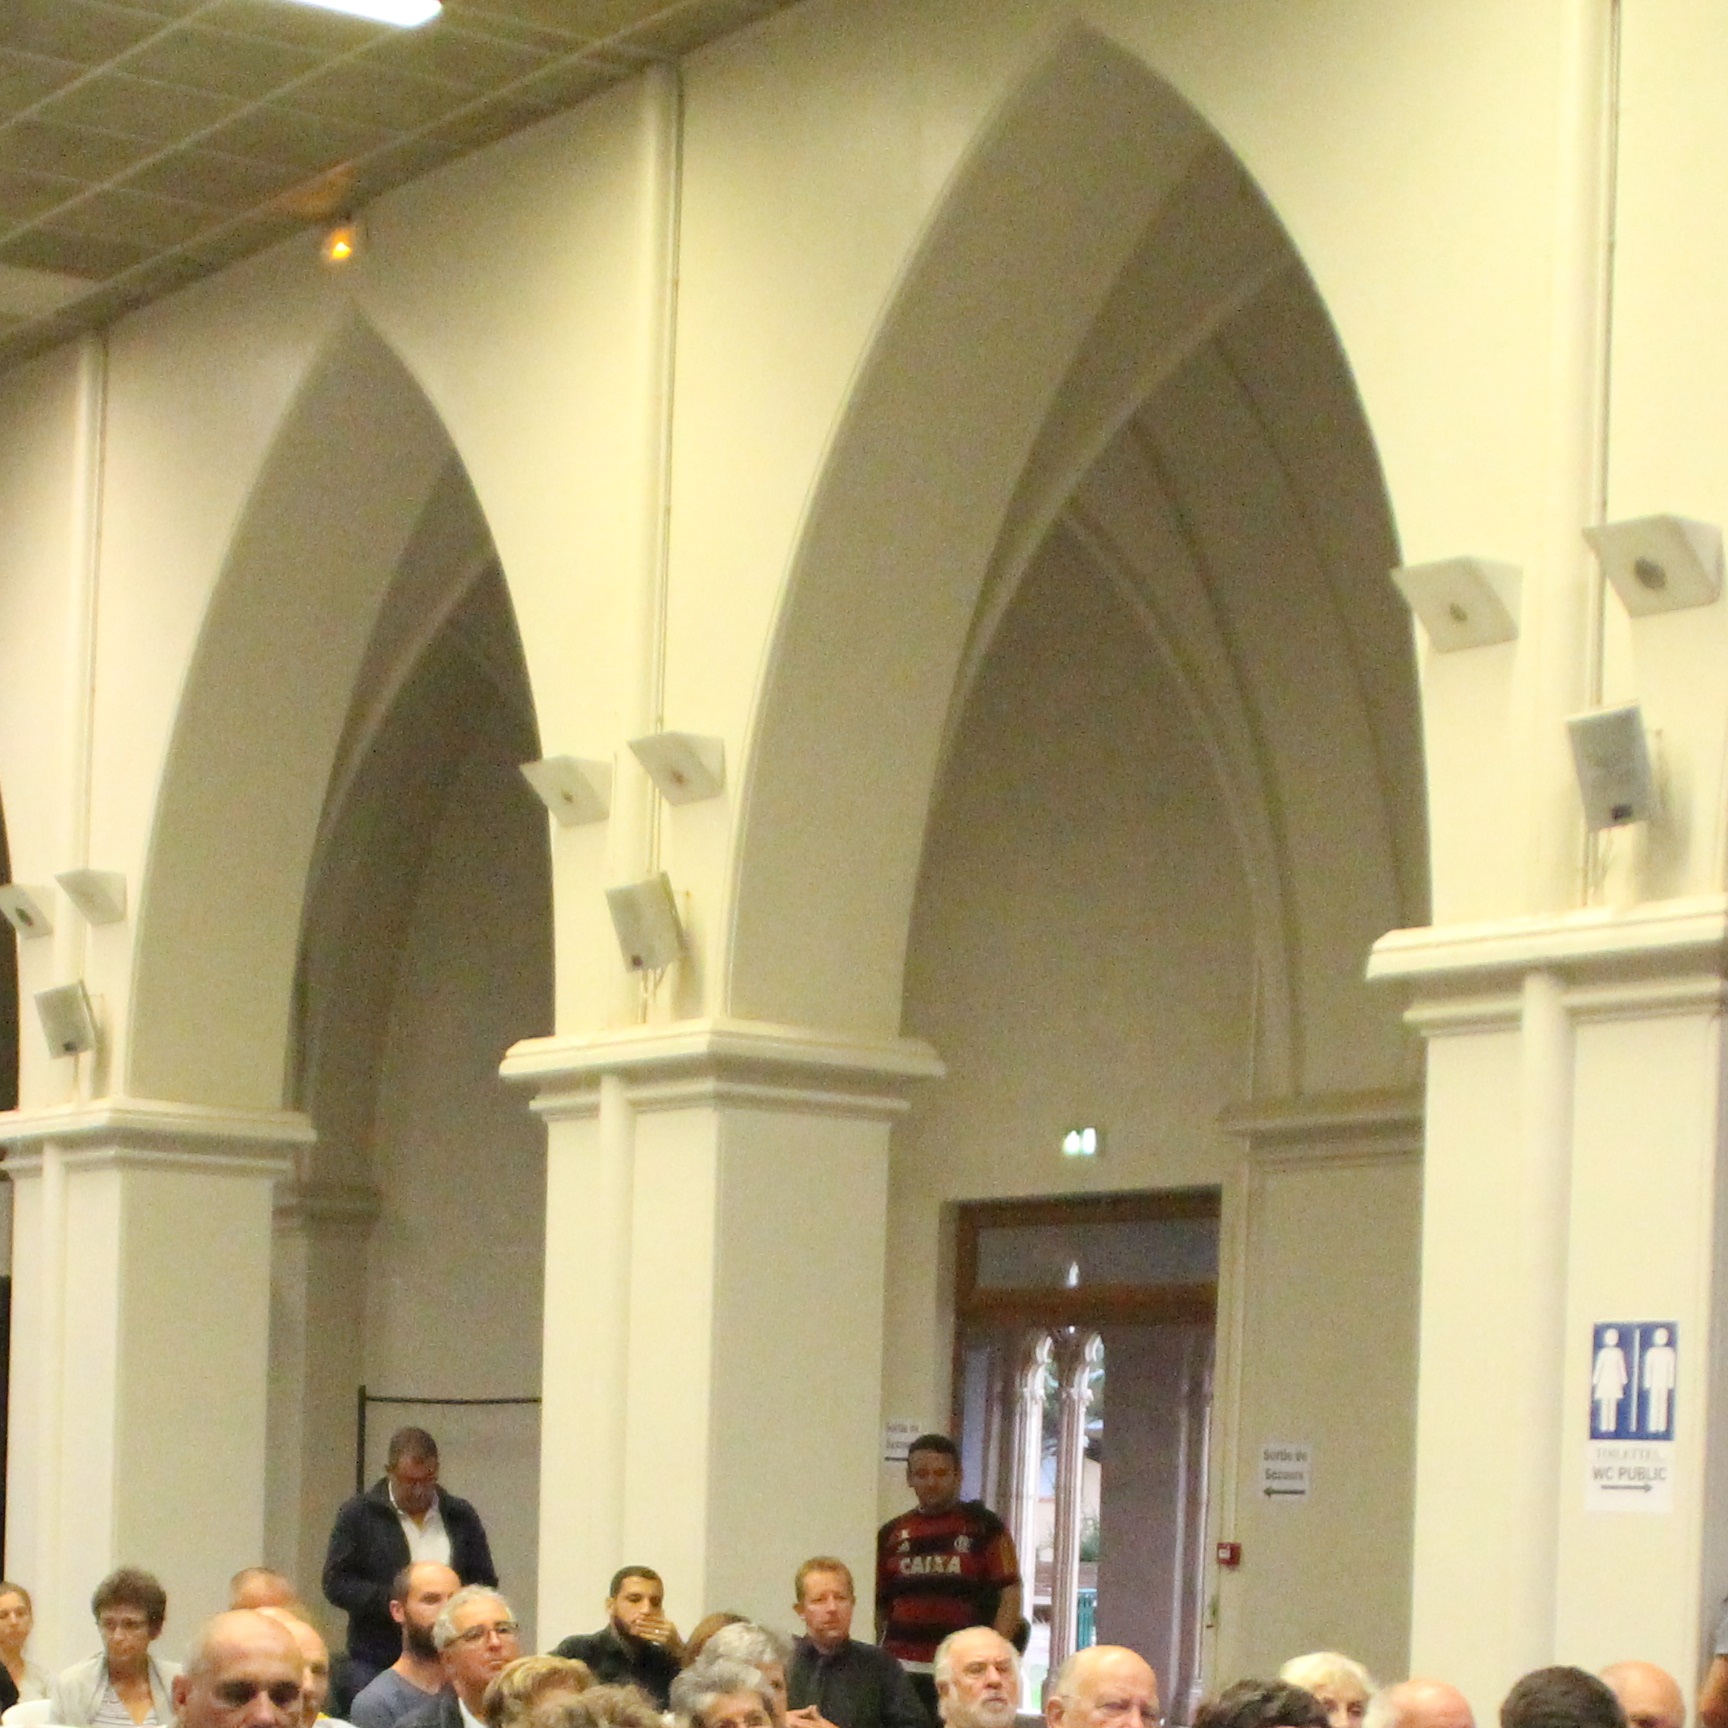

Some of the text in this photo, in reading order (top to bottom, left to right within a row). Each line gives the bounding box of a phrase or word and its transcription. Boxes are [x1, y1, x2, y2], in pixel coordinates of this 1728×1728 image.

[1592, 1466, 1668, 1481] WC PUBLIC
[898, 1555, 961, 1575] CAIXA
